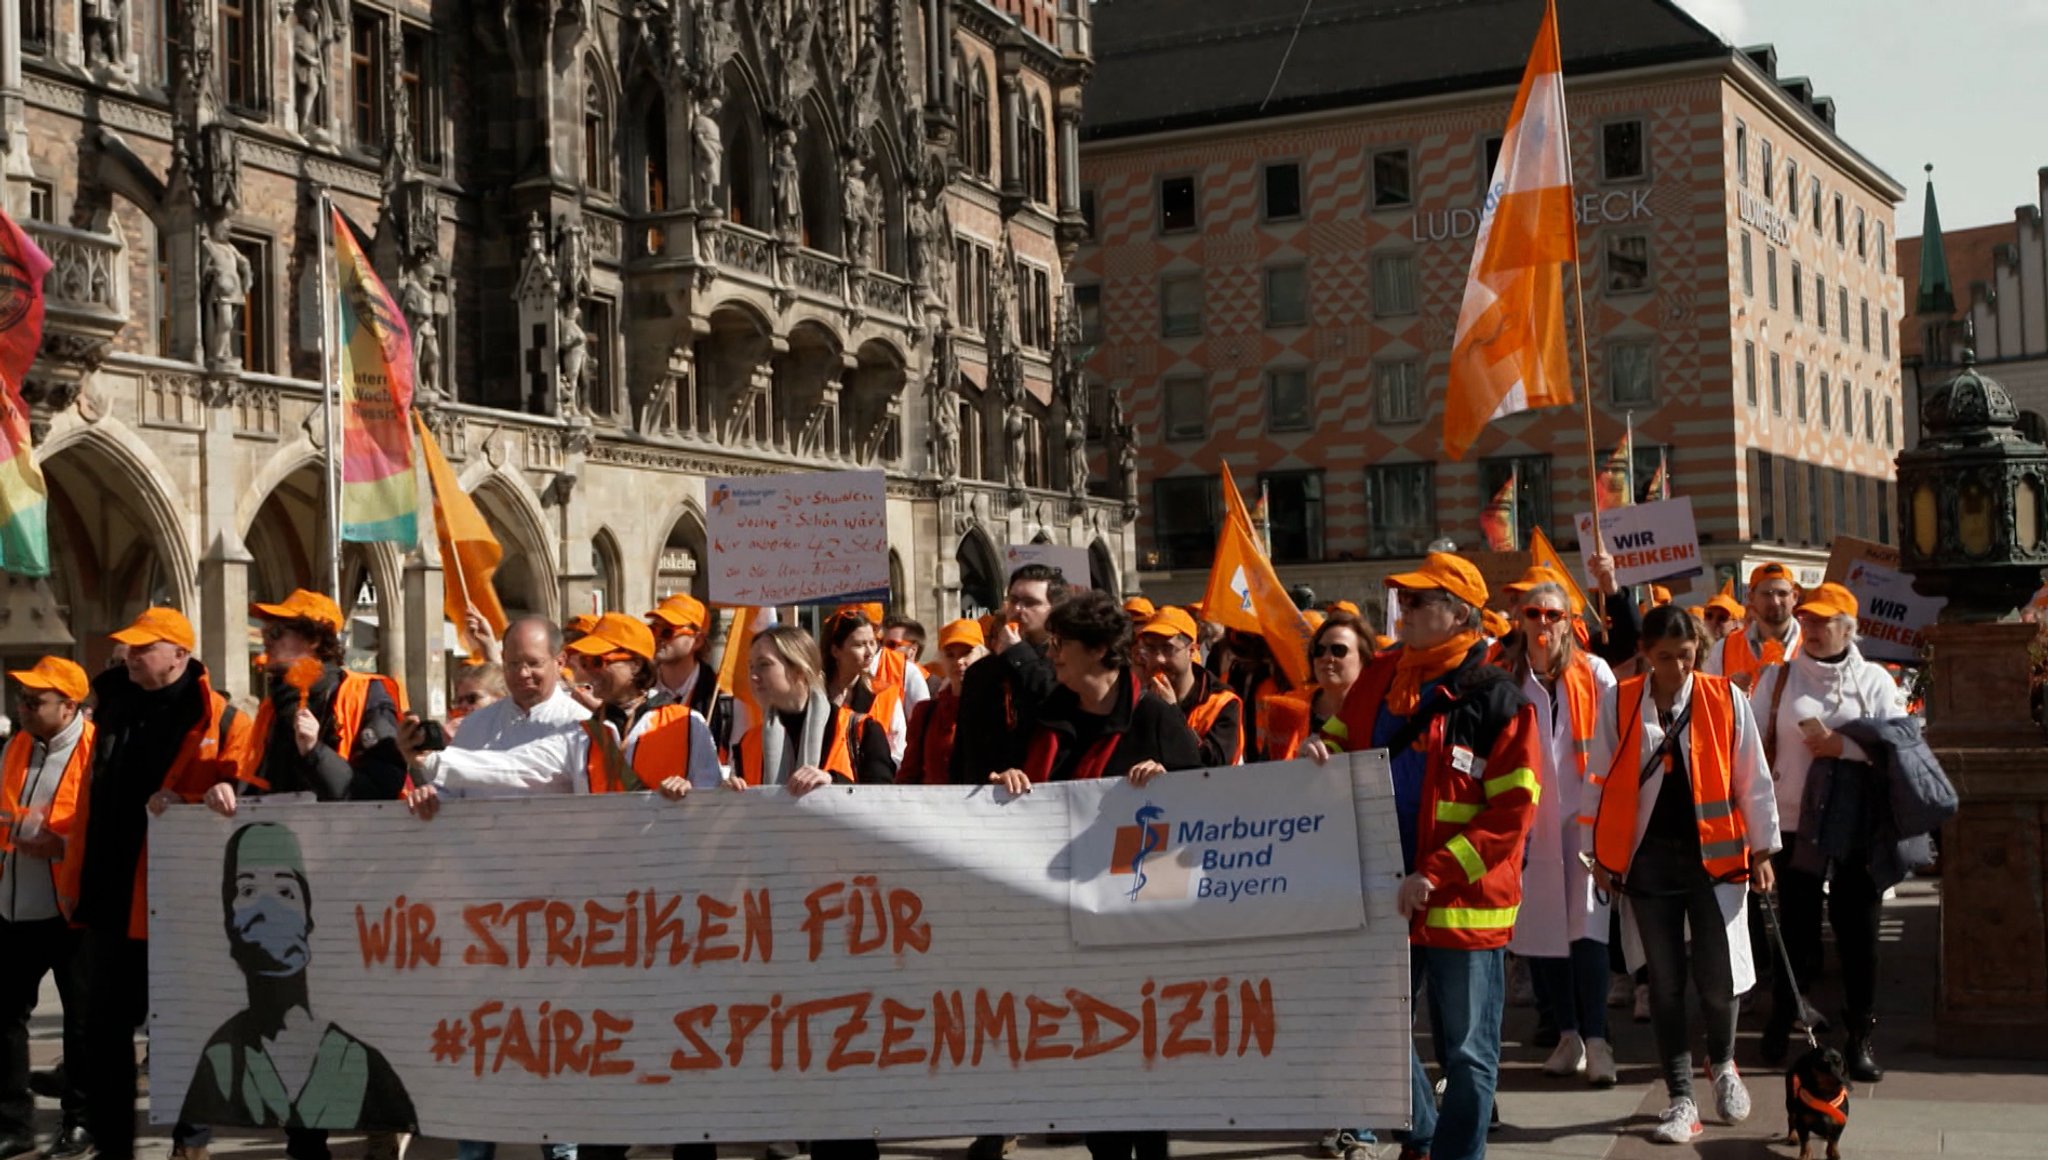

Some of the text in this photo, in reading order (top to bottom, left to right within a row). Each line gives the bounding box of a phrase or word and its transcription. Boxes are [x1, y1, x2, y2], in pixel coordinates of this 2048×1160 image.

[1612, 531, 1655, 550] WIR
[1613, 543, 1695, 569] REIKEN!
[1870, 597, 1909, 621] WIR
[1857, 618, 1929, 650] REIKEN
[1177, 814, 1325, 844] Marburger
[1202, 844, 1273, 871] Bund
[1197, 875, 1287, 904] Bayern
[799, 874, 931, 962] FÜR
